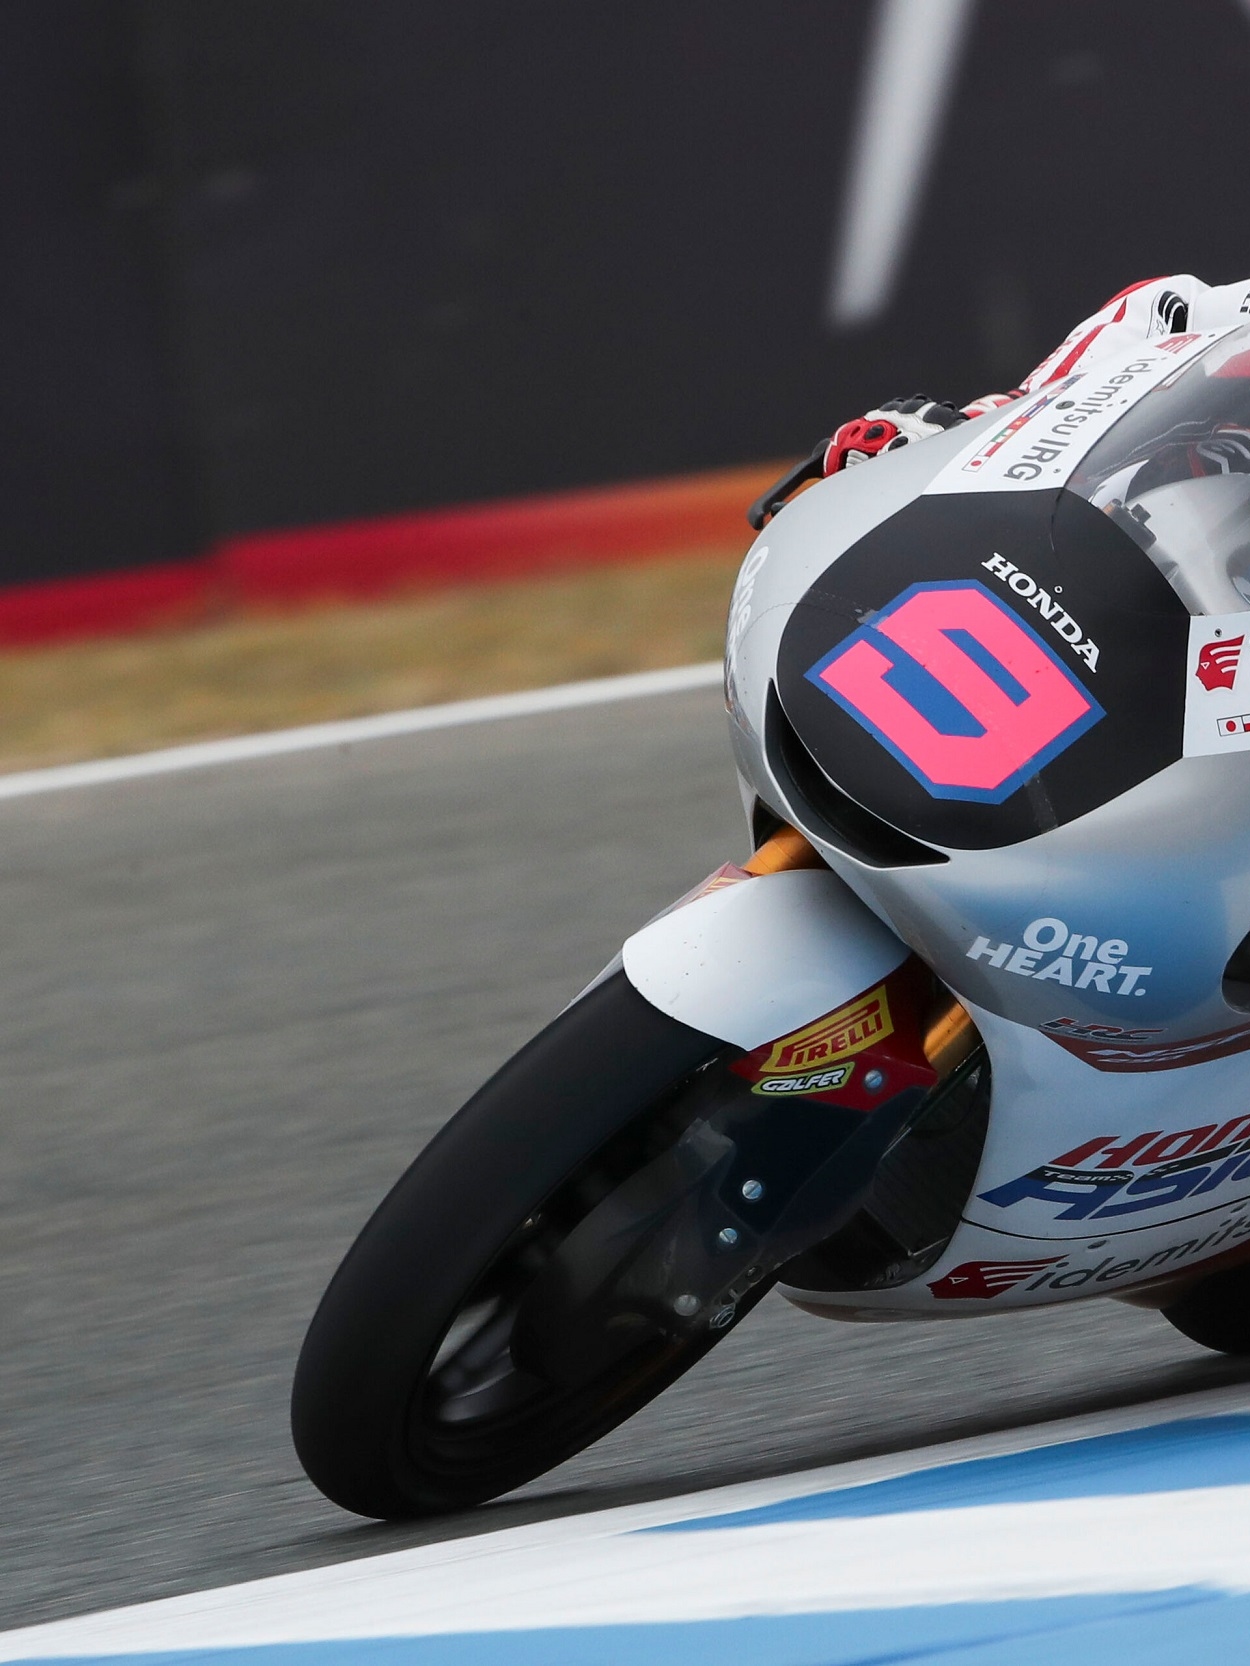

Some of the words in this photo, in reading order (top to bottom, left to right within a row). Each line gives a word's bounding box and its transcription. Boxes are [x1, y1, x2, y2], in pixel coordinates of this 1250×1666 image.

[1052, 356, 1167, 436] idemitsu
[1003, 438, 1070, 481] IRG
[981, 552, 1103, 674] HONDA
[816, 587, 1094, 792] 9
[966, 935, 1153, 997] HEART.
[1023, 917, 1129, 965] One
[775, 999, 883, 1068] PIRELLI
[762, 1067, 846, 1092] GALFER
